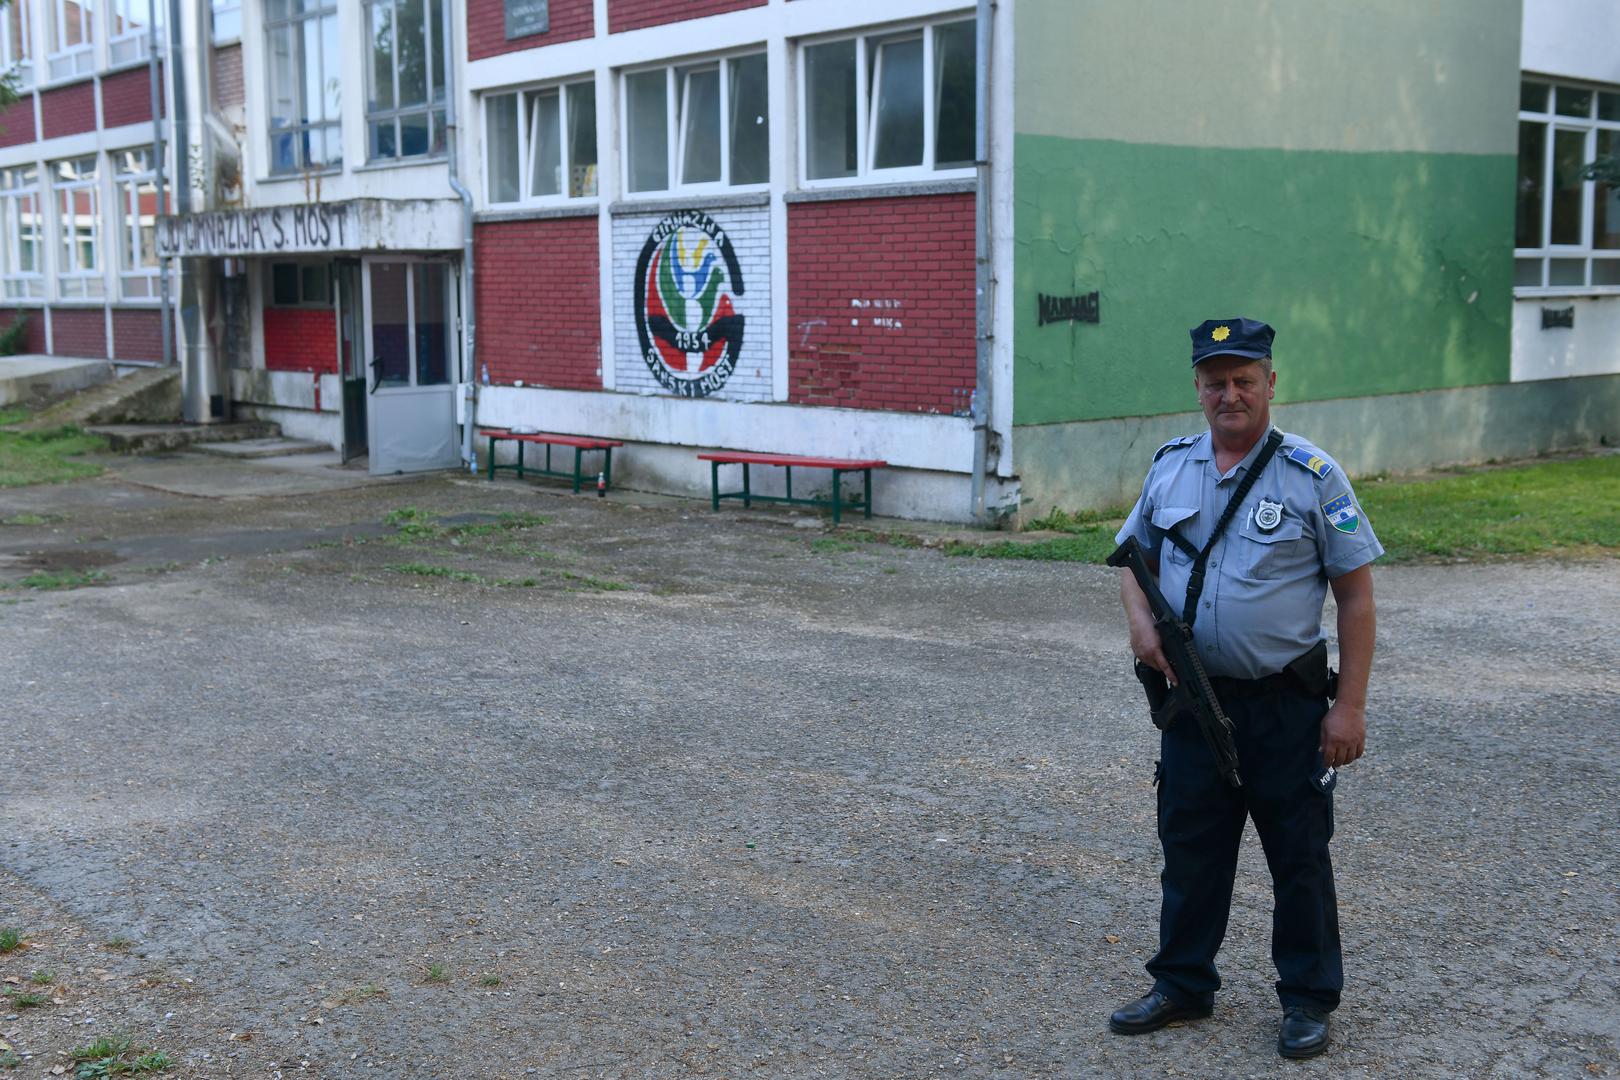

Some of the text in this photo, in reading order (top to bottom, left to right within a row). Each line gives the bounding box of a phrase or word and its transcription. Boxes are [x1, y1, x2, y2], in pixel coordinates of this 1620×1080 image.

[272, 208, 289, 249] S.
[294, 202, 347, 248] MOST
[653, 210, 724, 248] GIMNAZIJA
[675, 331, 712, 350] 1954
[646, 348, 732, 397] SANSKI MOST
